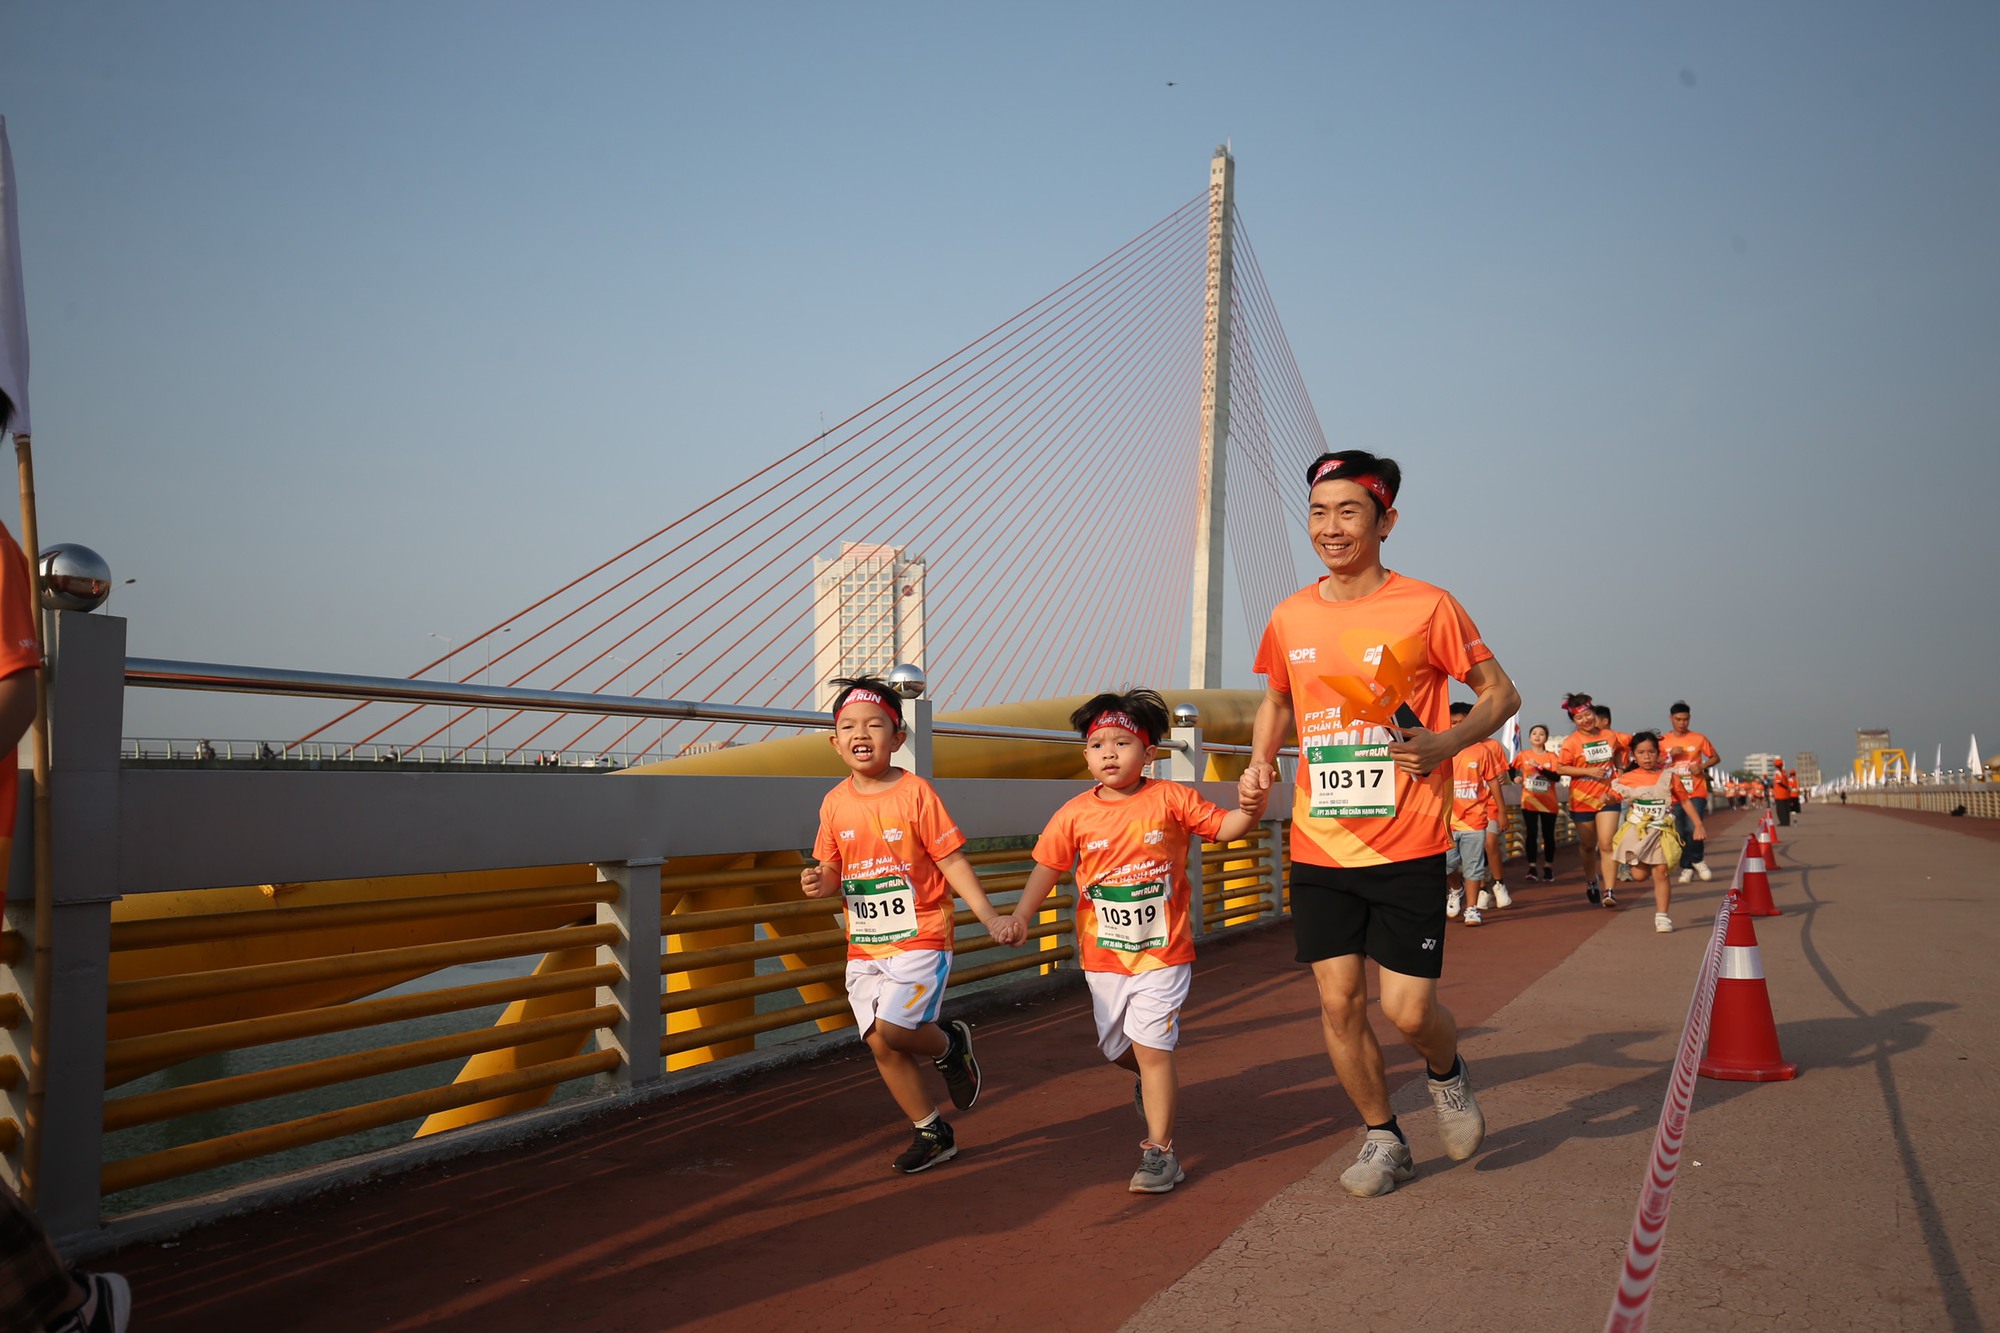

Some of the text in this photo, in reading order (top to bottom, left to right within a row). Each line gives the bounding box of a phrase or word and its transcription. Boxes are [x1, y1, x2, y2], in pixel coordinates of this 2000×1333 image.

[1363, 645, 1384, 665] FP
[856, 692, 882, 704] RUN
[1305, 711, 1325, 721] FPT
[1118, 716, 1138, 733] RUN
[1308, 720, 1331, 733] CHÂN
[1370, 747, 1389, 757] RUN
[1320, 769, 1384, 789] 10317
[860, 858, 874, 870] 35
[1111, 864, 1131, 876] 35
[1132, 860, 1155, 871] NĂM
[888, 879, 904, 888] RUN
[1144, 885, 1160, 894] RUN
[854, 897, 906, 919] 10318
[1101, 904, 1156, 926] 10319
